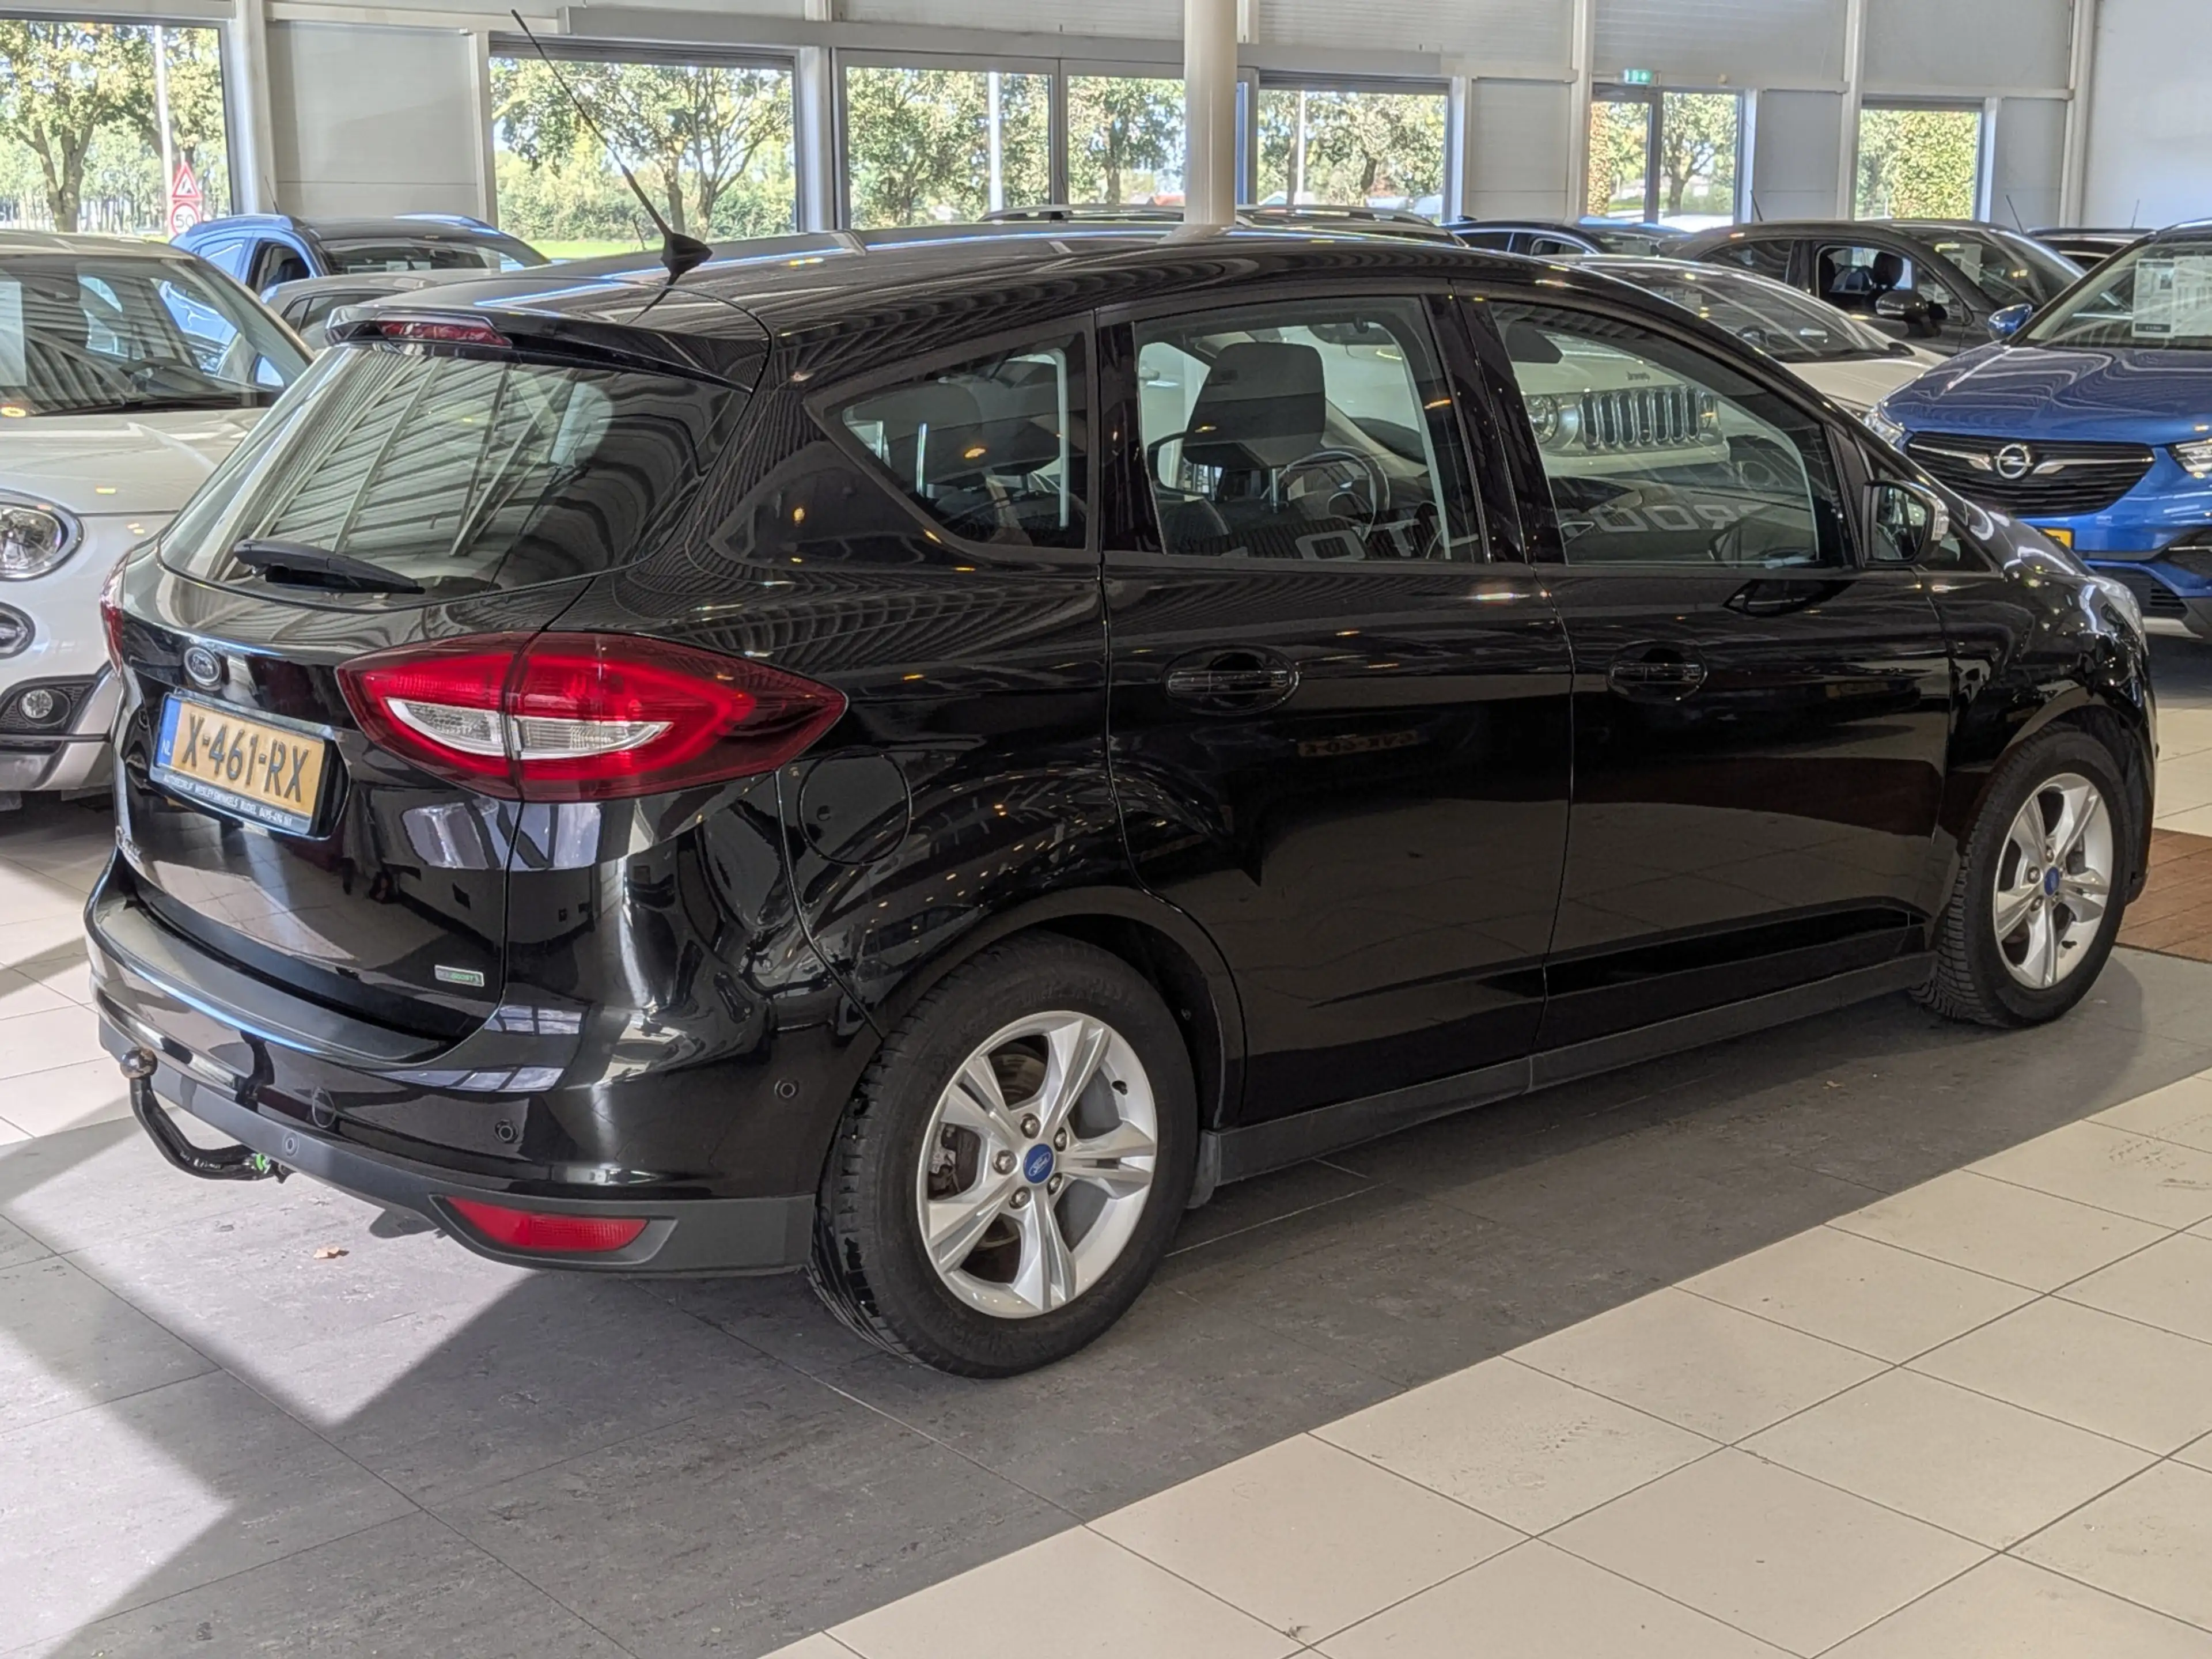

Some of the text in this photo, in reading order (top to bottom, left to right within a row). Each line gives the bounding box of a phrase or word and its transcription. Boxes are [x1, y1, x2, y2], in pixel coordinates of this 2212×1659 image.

[175, 214, 195, 229] 50
[161, 739, 171, 756] NL
[181, 712, 308, 802] X-461-RX
